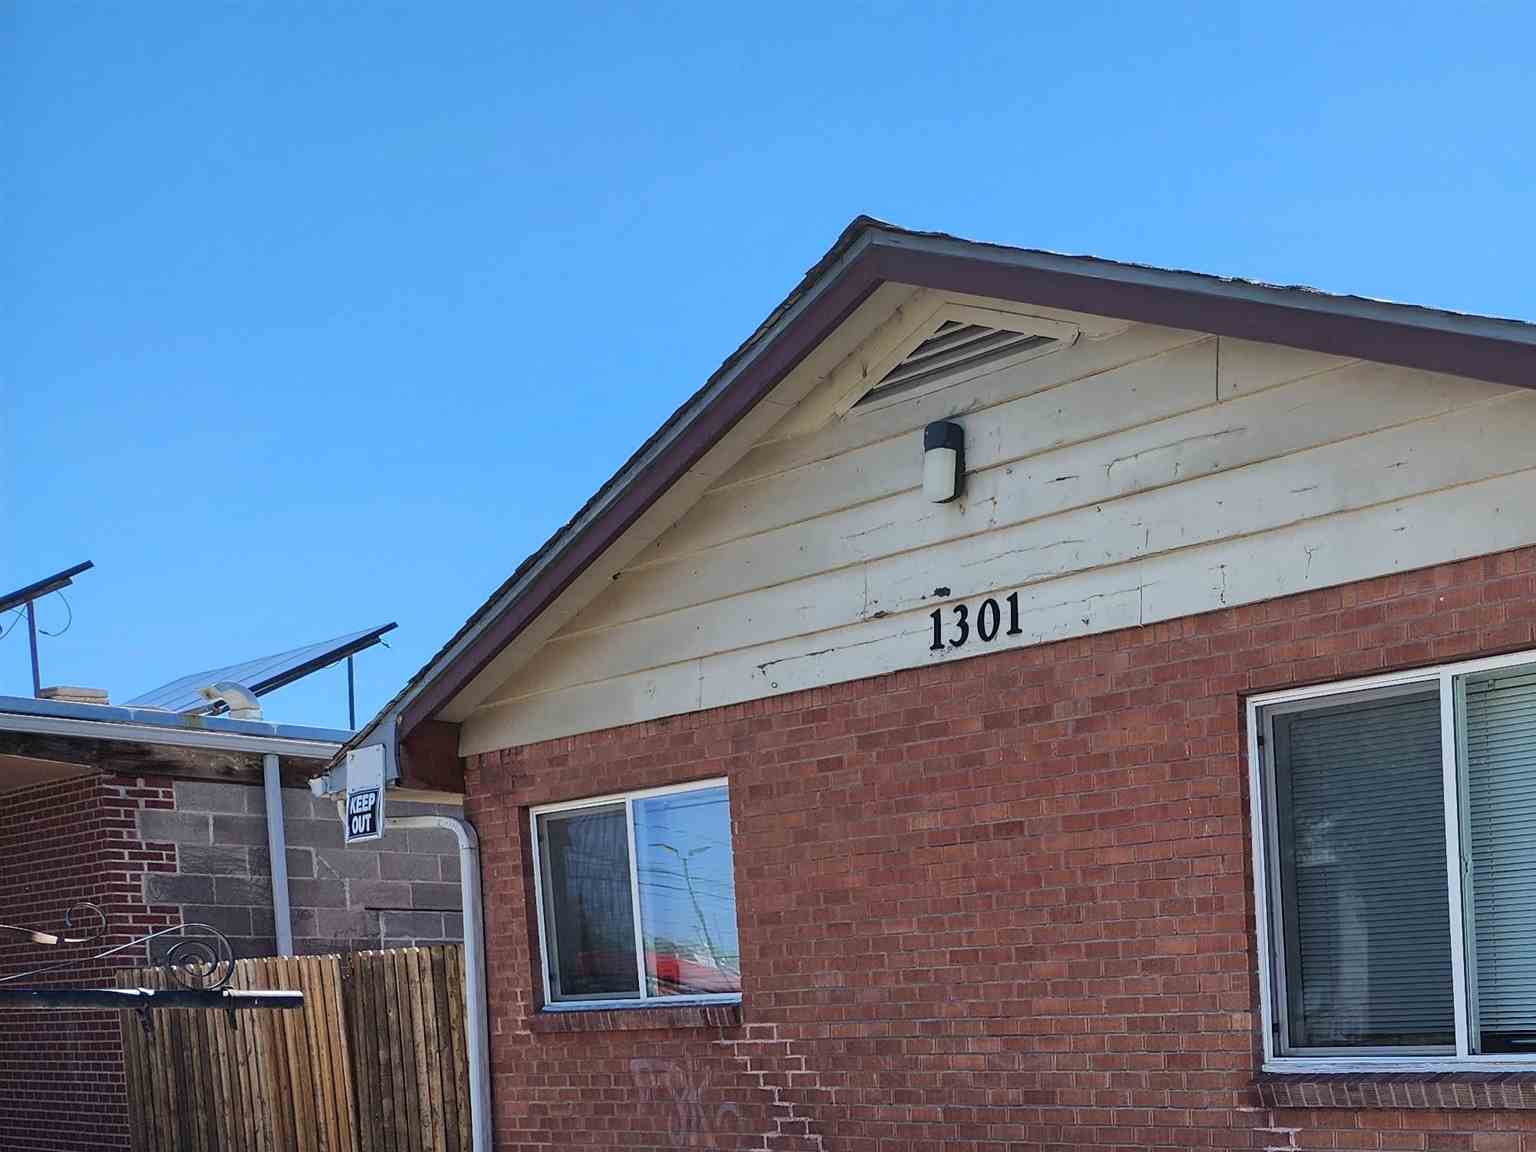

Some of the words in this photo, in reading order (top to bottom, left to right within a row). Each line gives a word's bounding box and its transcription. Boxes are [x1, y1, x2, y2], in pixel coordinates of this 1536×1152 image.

[929, 591, 1022, 650] 1301
[350, 792, 376, 814] KEEP
[352, 813, 371, 834] OUT
